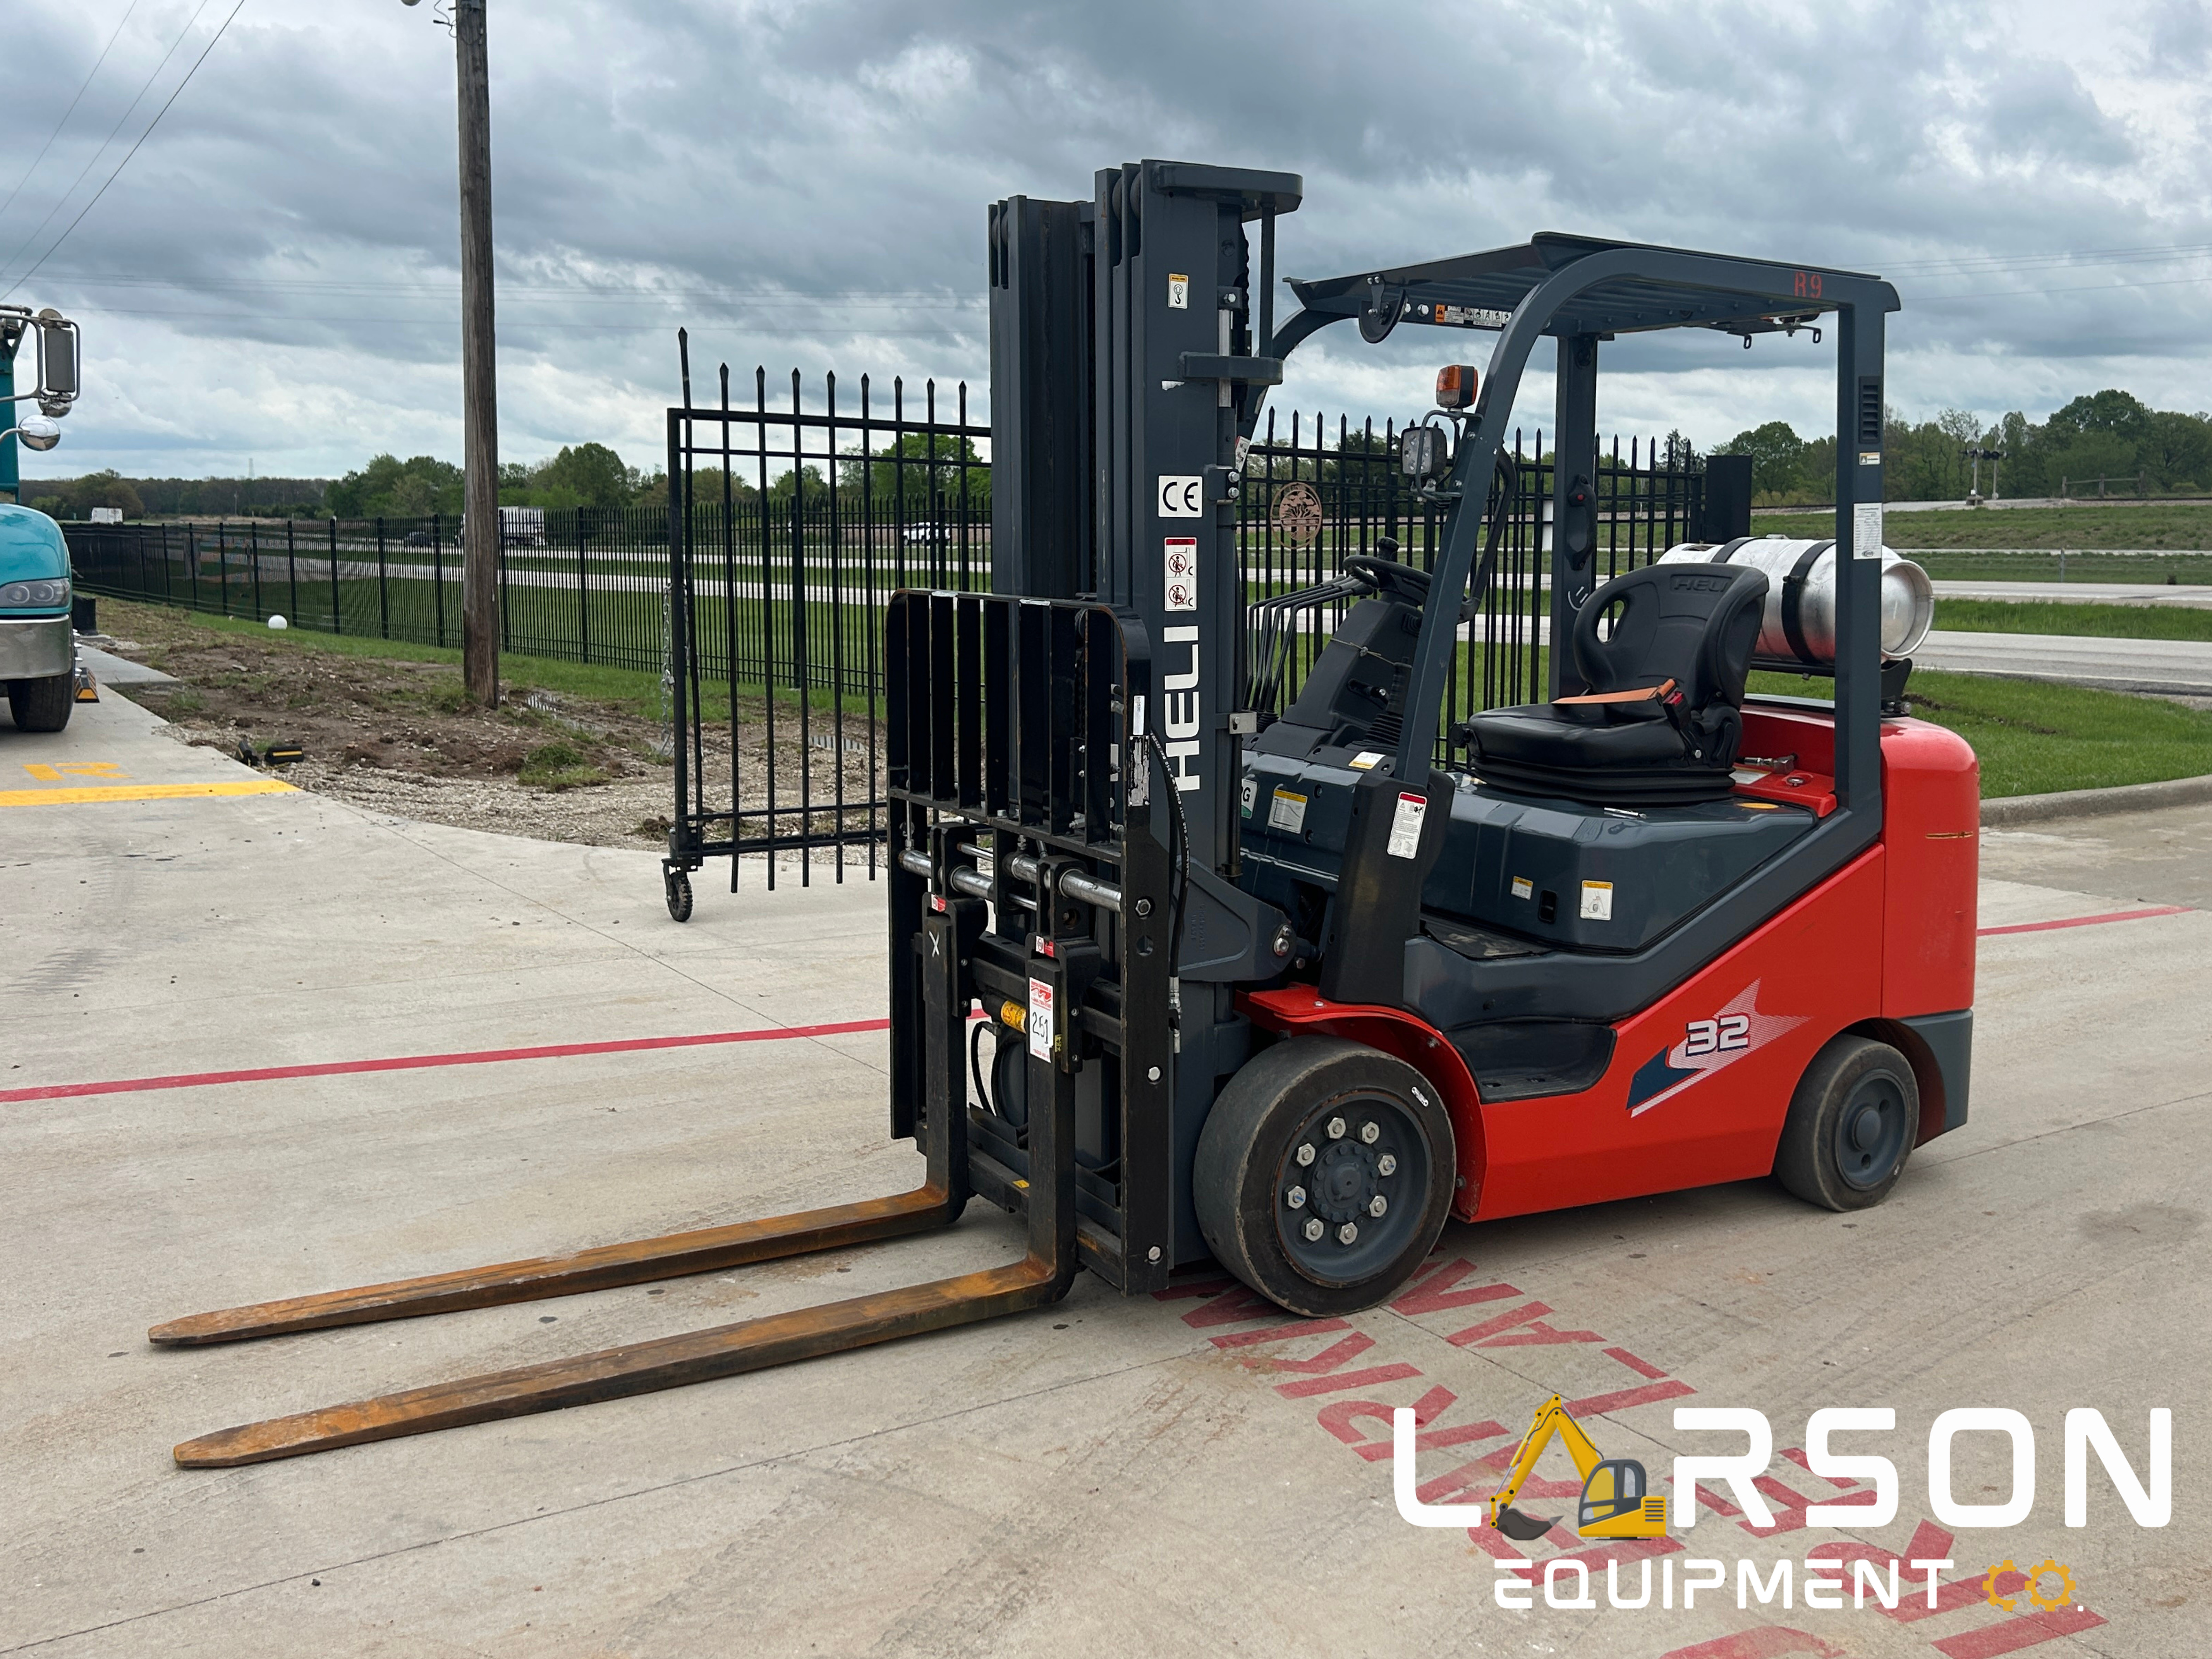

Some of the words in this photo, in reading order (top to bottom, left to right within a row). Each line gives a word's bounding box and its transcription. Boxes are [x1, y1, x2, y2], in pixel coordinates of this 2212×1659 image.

[1795, 273, 1822, 298] R9
[1163, 481, 1199, 512] CE
[1163, 625, 1200, 791] HELI
[1685, 1012, 1751, 1057] 32
